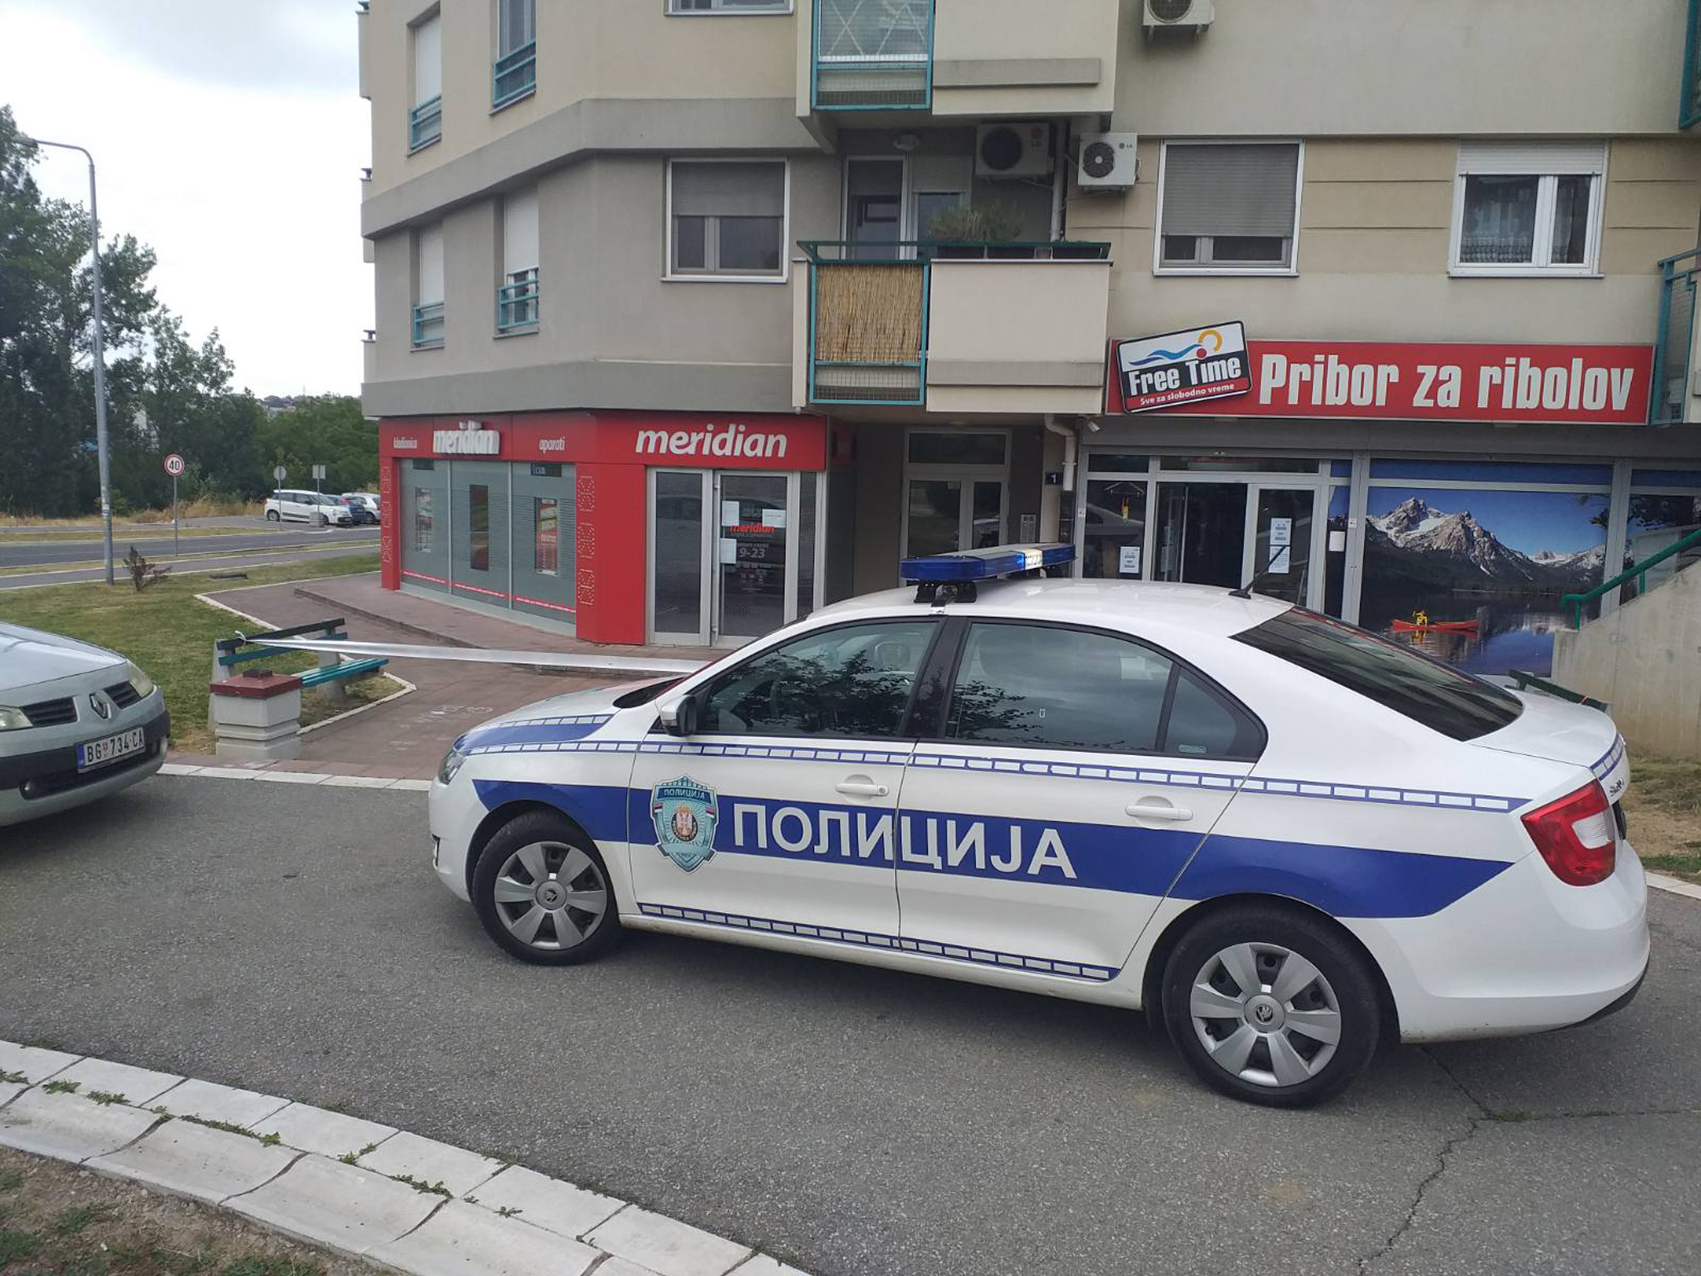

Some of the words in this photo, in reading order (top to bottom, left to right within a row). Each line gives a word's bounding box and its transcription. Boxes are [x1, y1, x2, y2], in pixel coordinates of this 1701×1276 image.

[1129, 368, 1180, 396] Free
[1185, 357, 1241, 386] Time
[1259, 353, 1399, 407] Pribor
[1412, 365, 1463, 408] za
[1477, 357, 1634, 411] ribolov
[1140, 396, 1155, 405] Sve
[1167, 388, 1206, 400] slobodno
[1207, 383, 1234, 393] vreme
[433, 420, 500, 455] meridian
[538, 436, 567, 454] aparati
[635, 424, 788, 457] meridian
[169, 460, 180, 470] 40
[1050, 474, 1057, 483] 1
[740, 547, 766, 558] 9-23
[87, 743, 101, 762] BG
[664, 787, 705, 800] ПОЛИЦИЈА
[733, 803, 1078, 879] ПОЛИЦИЈА
